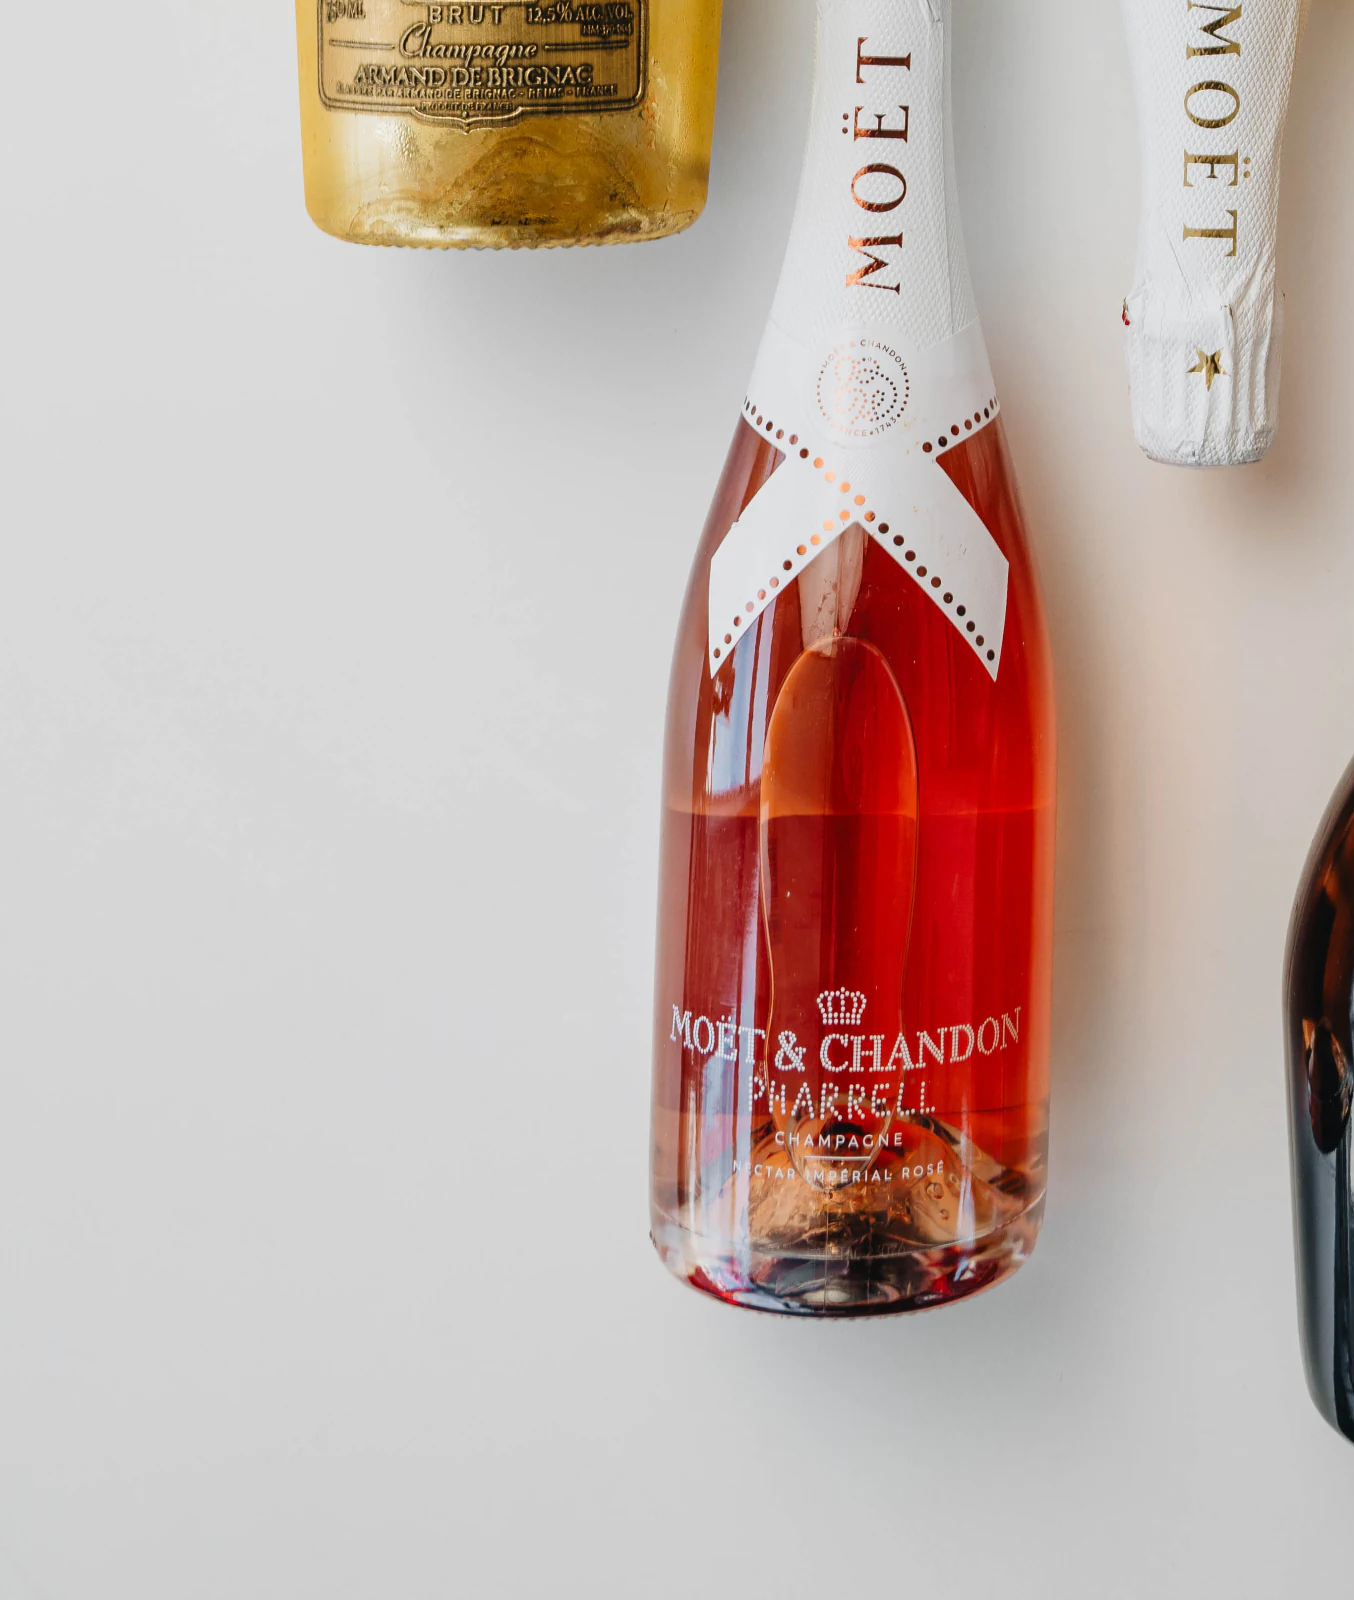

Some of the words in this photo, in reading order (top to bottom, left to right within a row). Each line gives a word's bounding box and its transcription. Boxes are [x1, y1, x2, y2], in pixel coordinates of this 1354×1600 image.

[427, 4, 505, 26] BRUT
[399, 21, 538, 67] Champagne
[353, 64, 447, 88] ARMAND
[451, 65, 482, 88] DE
[486, 64, 594, 88] BRIGNAC
[464, 87, 517, 100] BRIGNAC
[842, 36, 912, 295] MOËT
[875, 416, 897, 435] 1743
[669, 1003, 766, 1065] MOËT
[774, 1030, 807, 1072] &
[819, 1006, 1023, 1073] CHANDON
[747, 1074, 937, 1122] PHARRELL
[774, 1131, 904, 1149] CHAMPAGNE
[733, 1159, 796, 1179] NECTAR
[806, 1168, 893, 1183] IMPÉRIAL
[902, 1160, 945, 1179] ROSÉ
